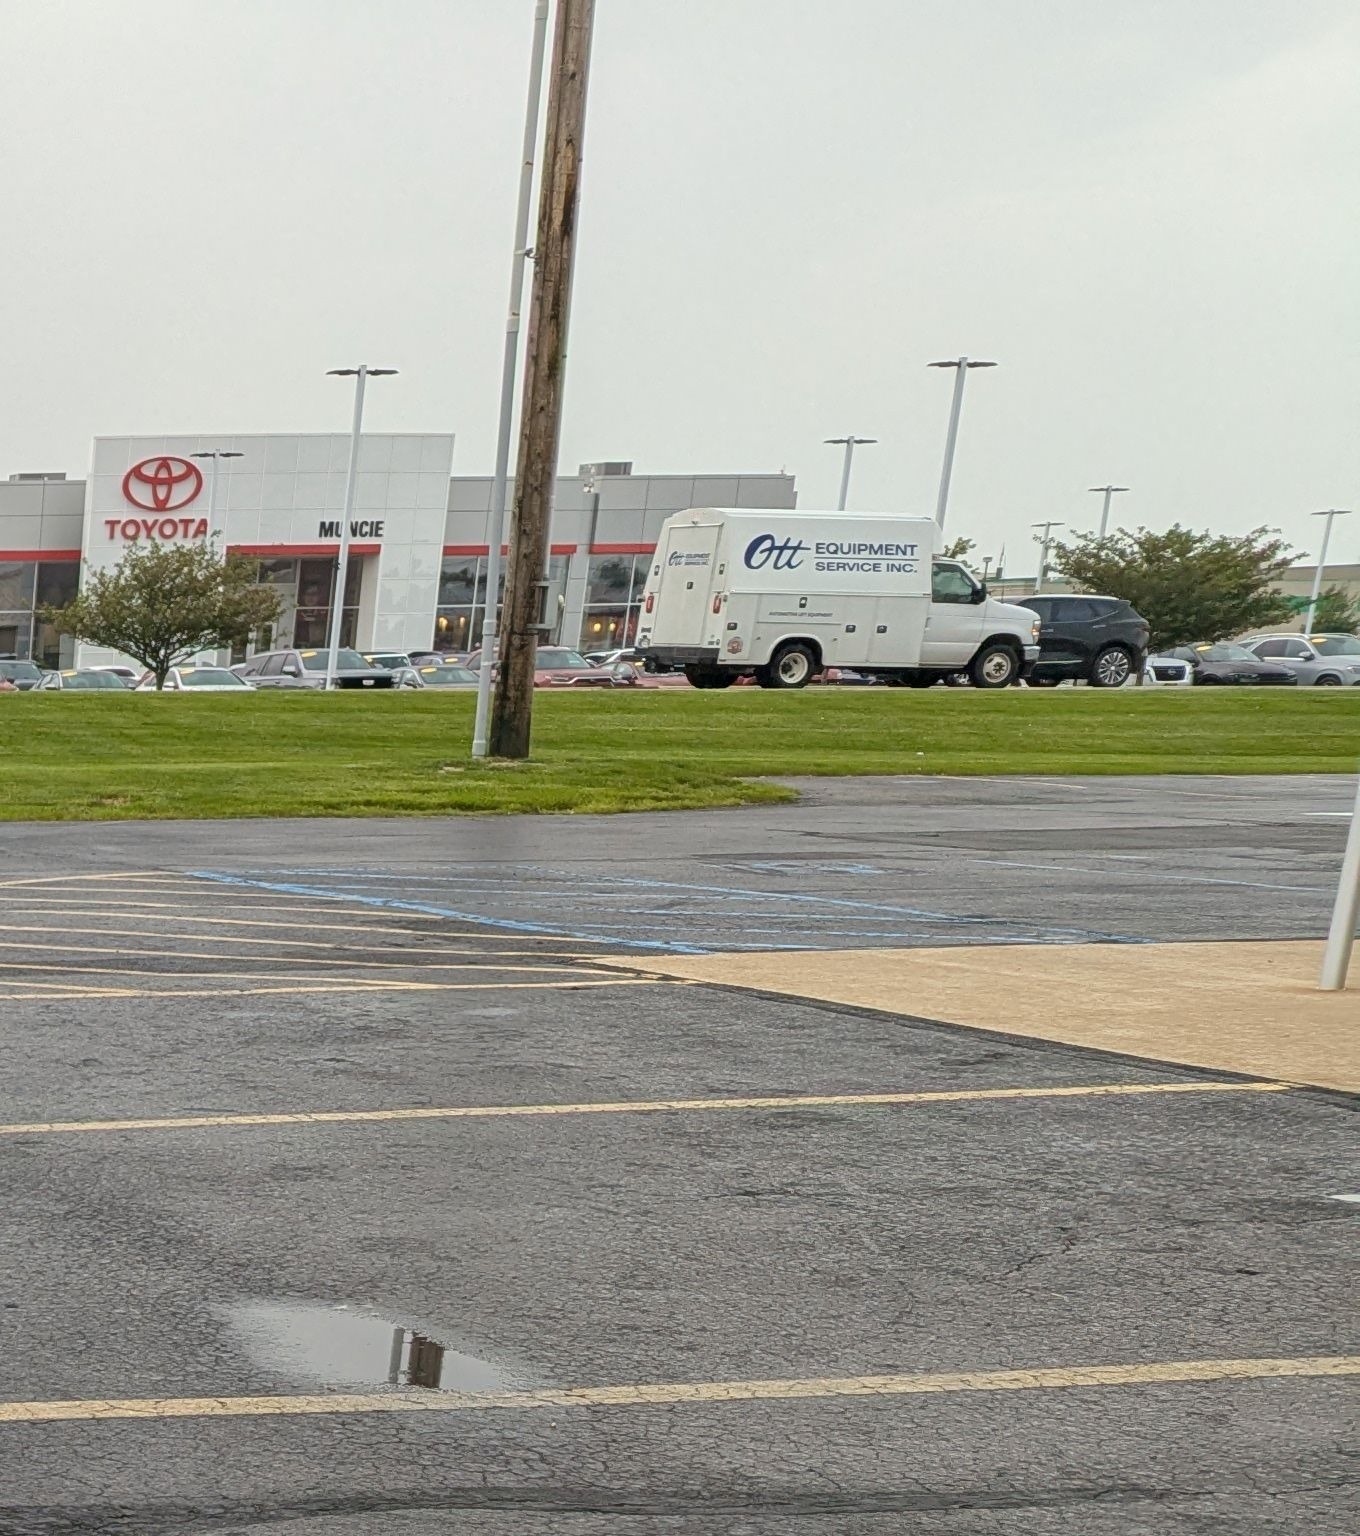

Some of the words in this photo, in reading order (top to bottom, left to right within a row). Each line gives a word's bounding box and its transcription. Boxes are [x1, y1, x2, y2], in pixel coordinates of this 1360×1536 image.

[104, 518, 209, 540] TOYOTA
[744, 533, 811, 570] Ott
[815, 542, 918, 557] EQUIPMENT
[814, 562, 883, 573] SERVICE
[886, 563, 918, 574] INC.
